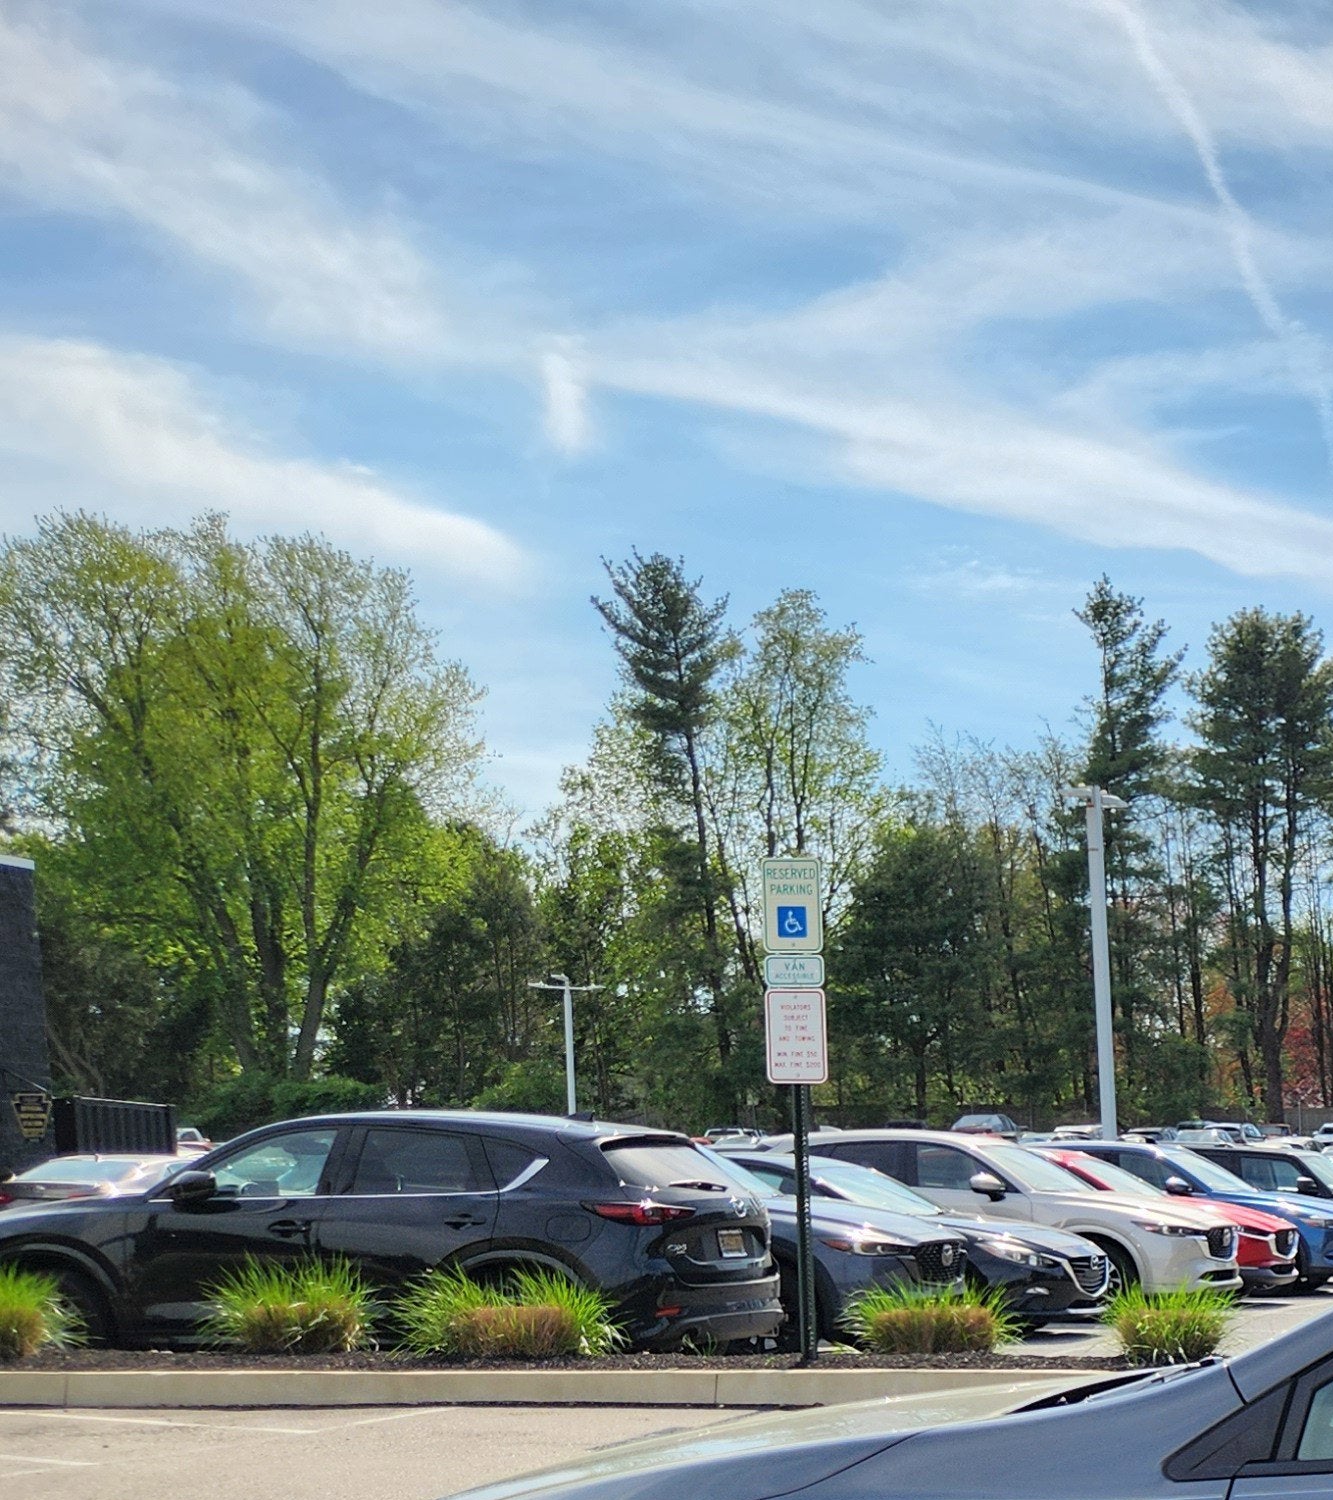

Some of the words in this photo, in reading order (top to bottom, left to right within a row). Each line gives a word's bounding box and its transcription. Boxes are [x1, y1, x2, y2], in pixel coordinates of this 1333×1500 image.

[766, 867, 816, 881] RESERVED
[770, 883, 814, 896] PARKING
[784, 962, 806, 971] VAN
